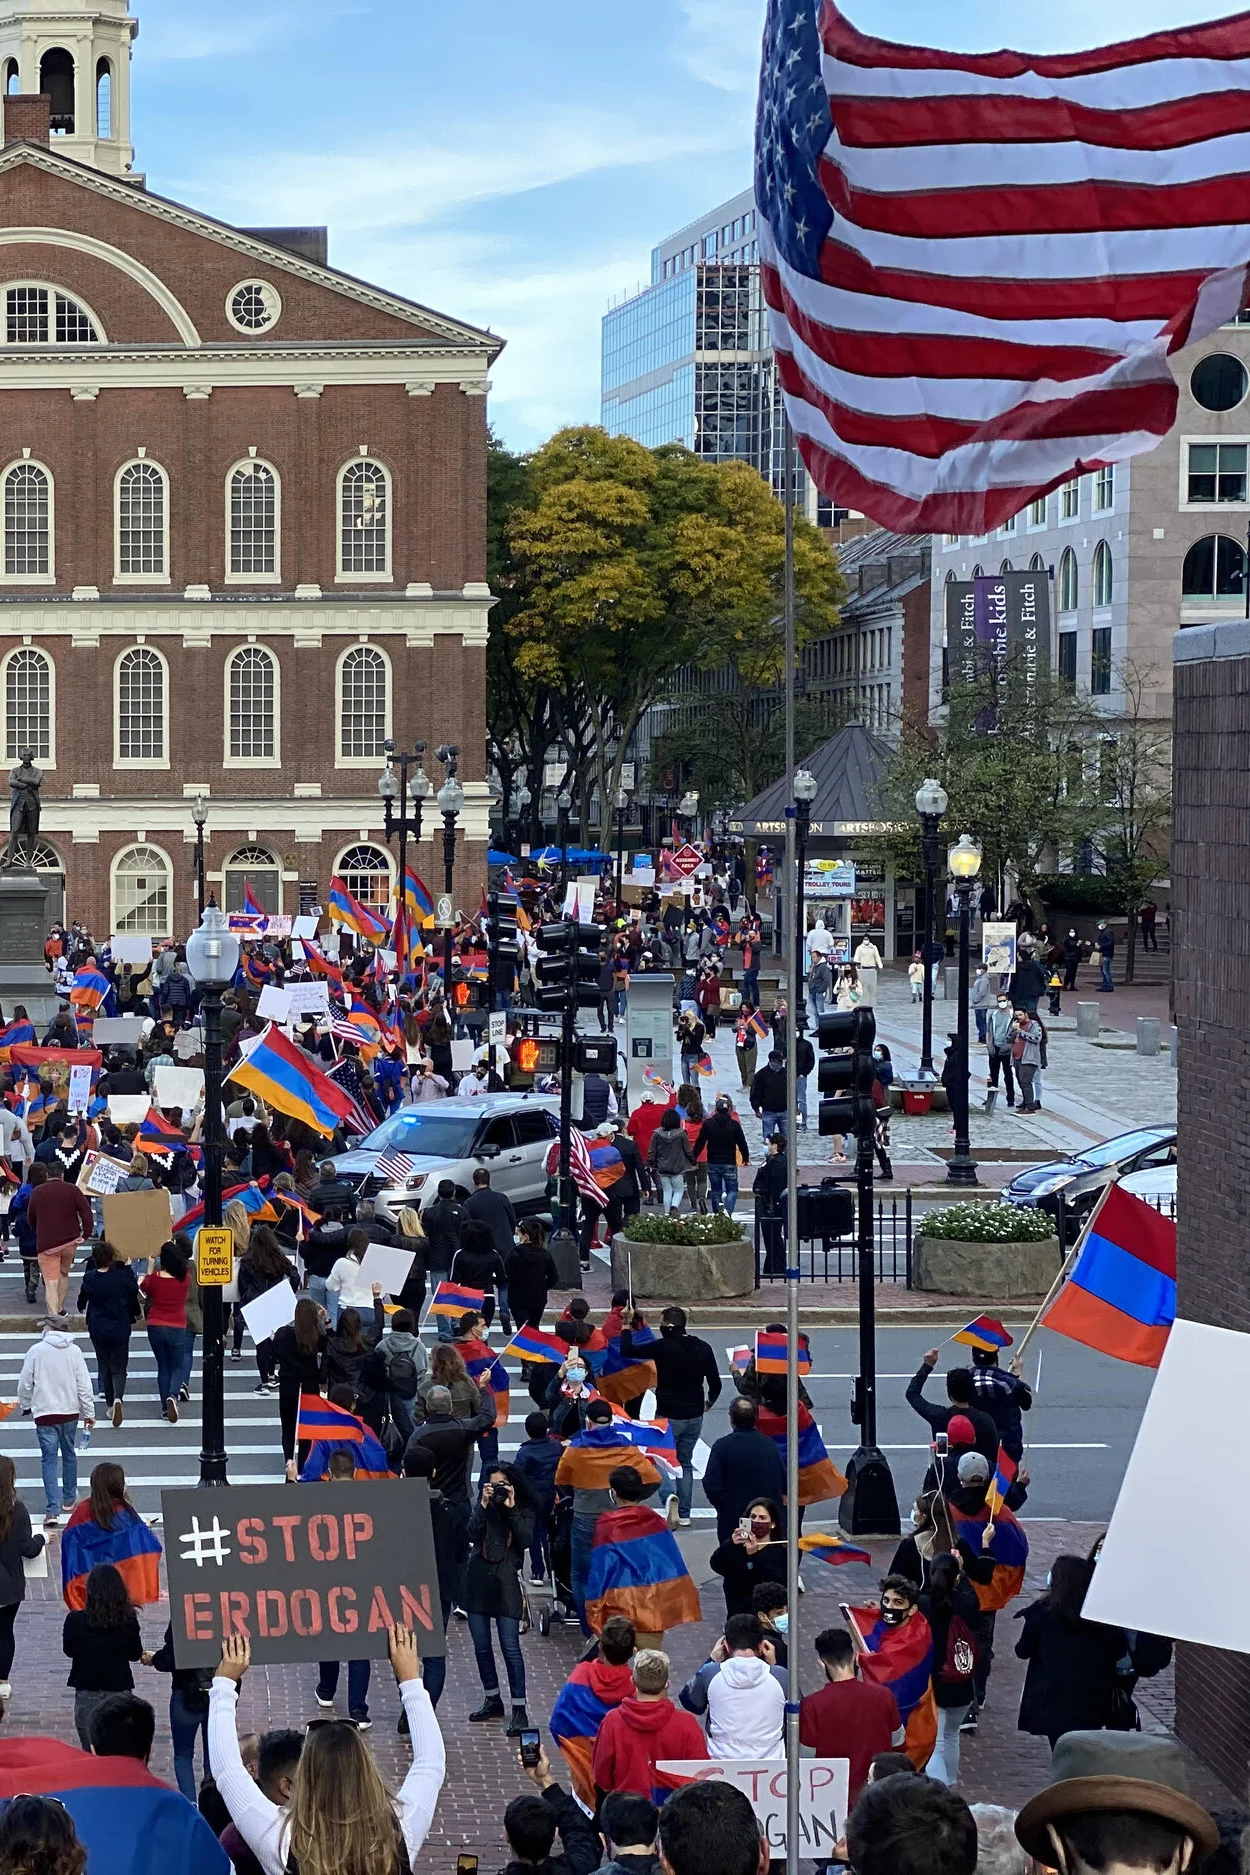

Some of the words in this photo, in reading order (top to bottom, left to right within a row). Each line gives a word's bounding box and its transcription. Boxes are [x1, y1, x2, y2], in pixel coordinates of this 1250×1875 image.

[987, 585, 1007, 624] kids
[1019, 583, 1036, 622] Fitch
[960, 594, 975, 630] Fitch
[1025, 627, 1037, 640] &
[491, 1020, 505, 1029] STOP
[491, 1029, 504, 1037] LINE
[205, 1236, 226, 1245] WATCH
[209, 1247, 222, 1255] FOR
[203, 1257, 228, 1266] TURNING
[201, 1267, 230, 1276] VEHICLES
[178, 1512, 374, 1568] #STOP
[183, 1583, 434, 1641] ERDOGAN
